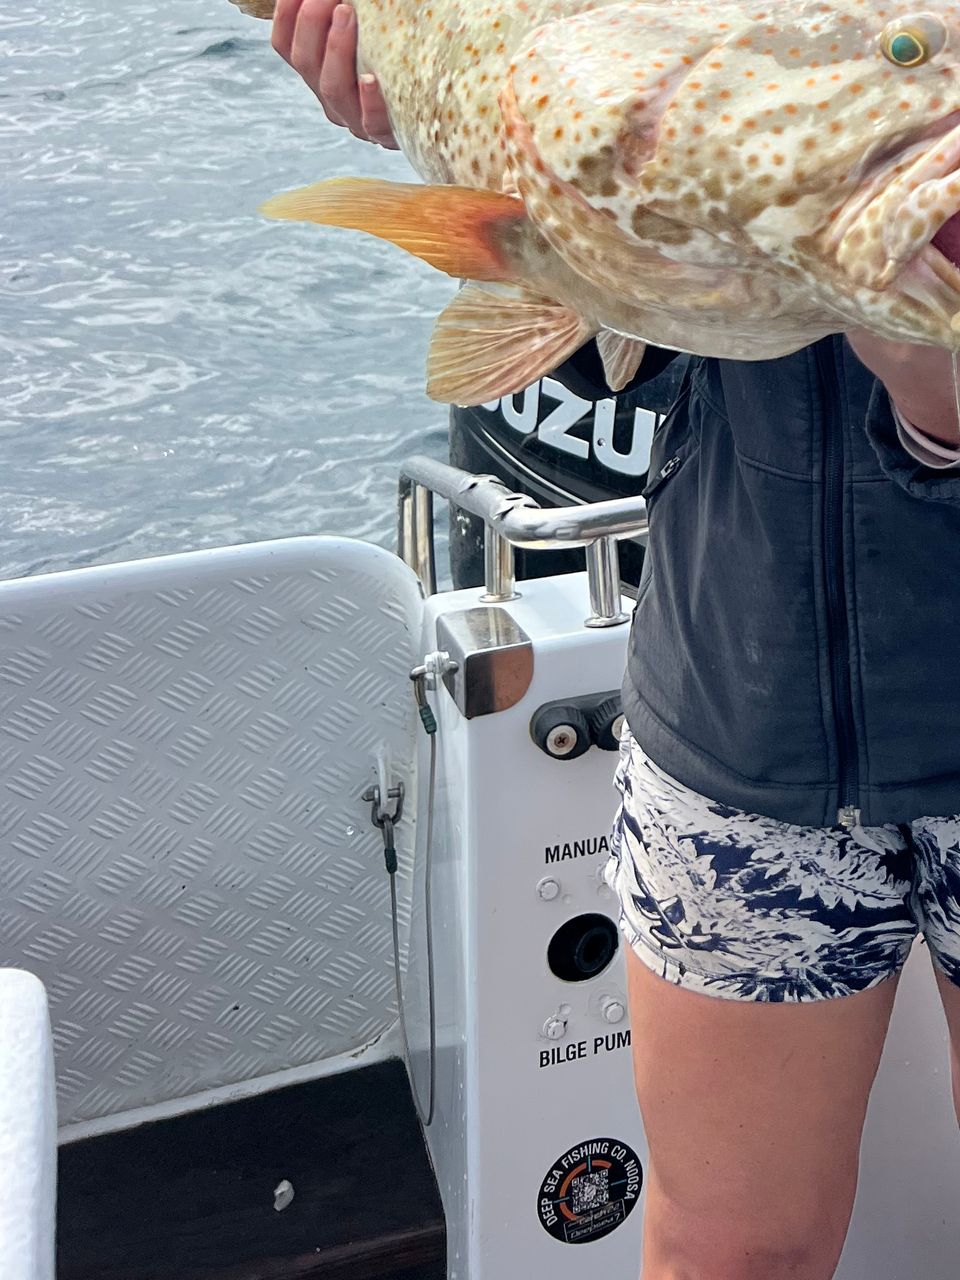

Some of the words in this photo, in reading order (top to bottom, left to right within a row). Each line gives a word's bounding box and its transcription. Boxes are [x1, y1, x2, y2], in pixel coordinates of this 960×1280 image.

[480, 376, 667, 476] UZU
[545, 834, 613, 864] MANUA
[540, 1041, 587, 1068] BILGE
[561, 1142, 609, 1169] FISHING
[610, 1145, 627, 1163] CO.
[543, 1169, 564, 1193] SEA
[623, 1159, 640, 1200] NOOSA
[541, 1198, 558, 1227] DEEP
